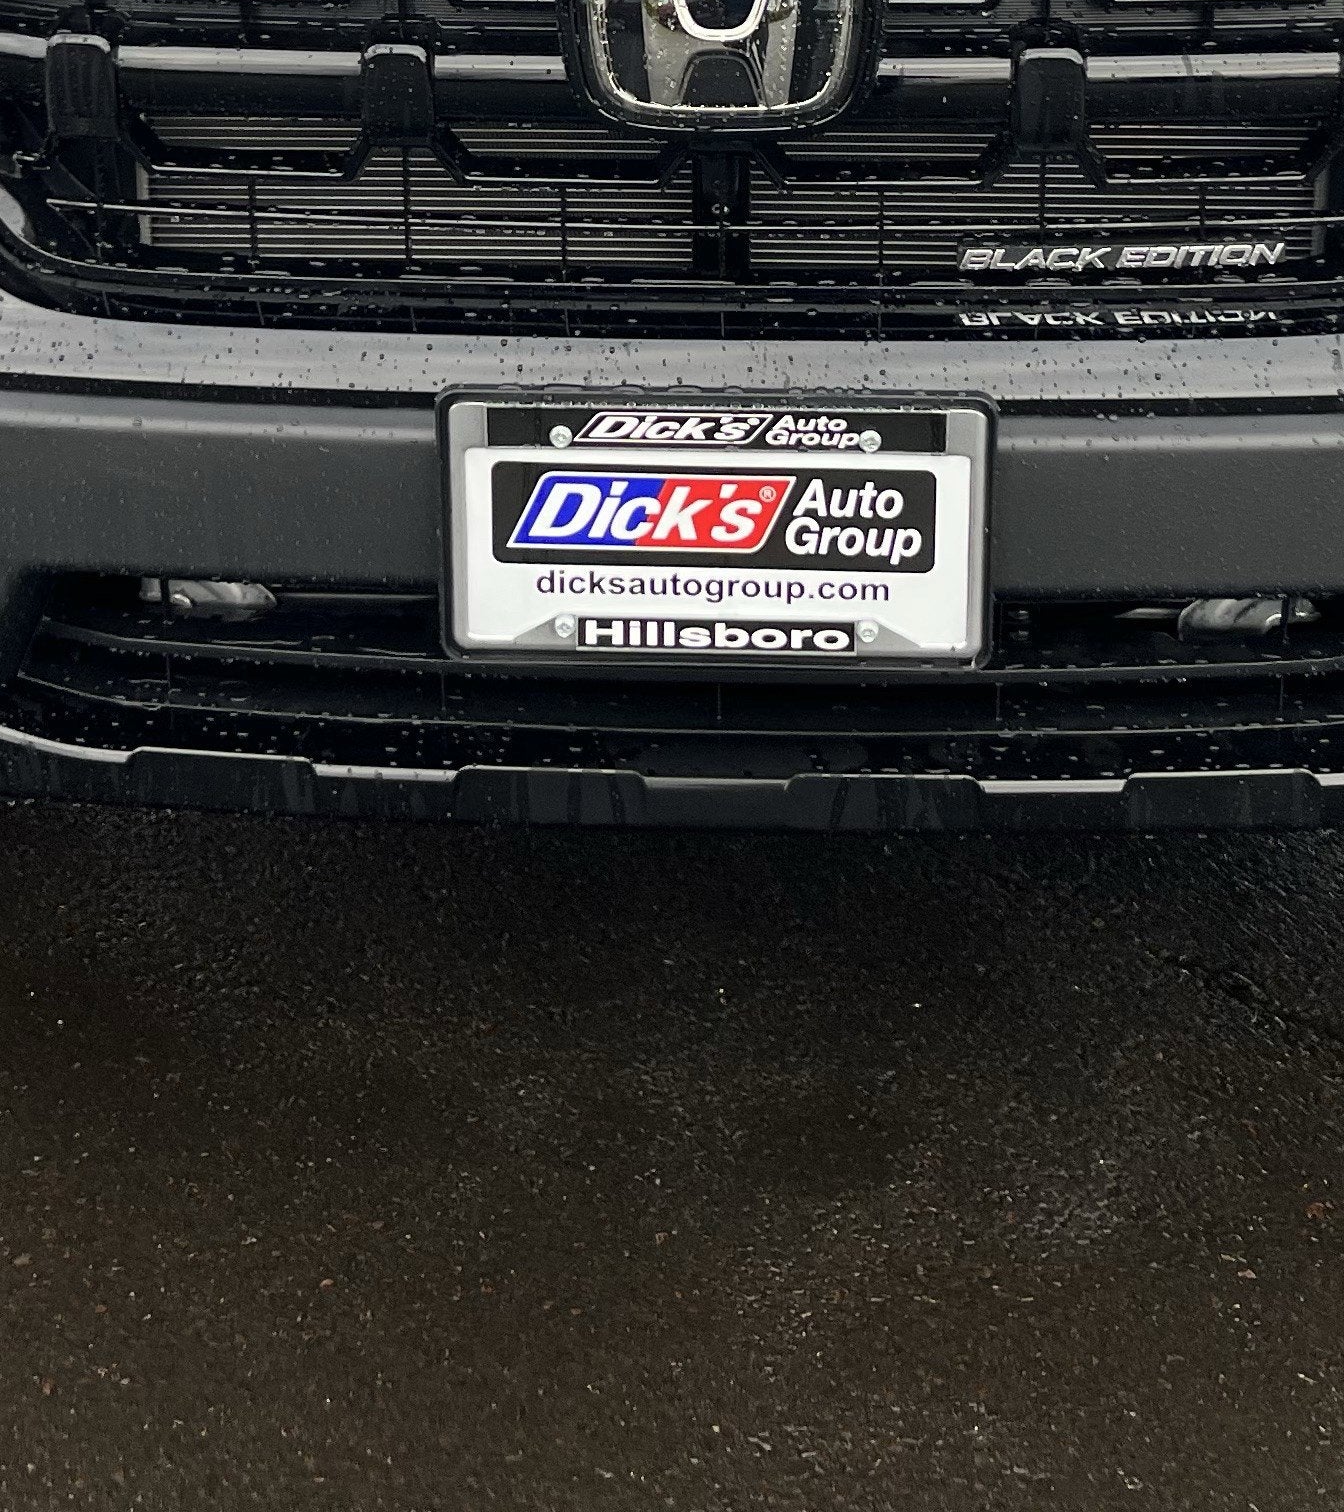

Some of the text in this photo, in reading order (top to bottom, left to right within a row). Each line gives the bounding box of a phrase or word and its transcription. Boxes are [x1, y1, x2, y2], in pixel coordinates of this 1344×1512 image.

[959, 242, 1286, 272] BLACK EDITION
[587, 414, 751, 441] Dick's
[764, 429, 860, 449] Group
[771, 414, 849, 432] Auto
[527, 480, 763, 543] Dick's
[792, 478, 905, 520] Auto
[784, 515, 923, 566] Group
[535, 569, 890, 605] dicksautogroup.com
[582, 620, 851, 652] Hillsboro
